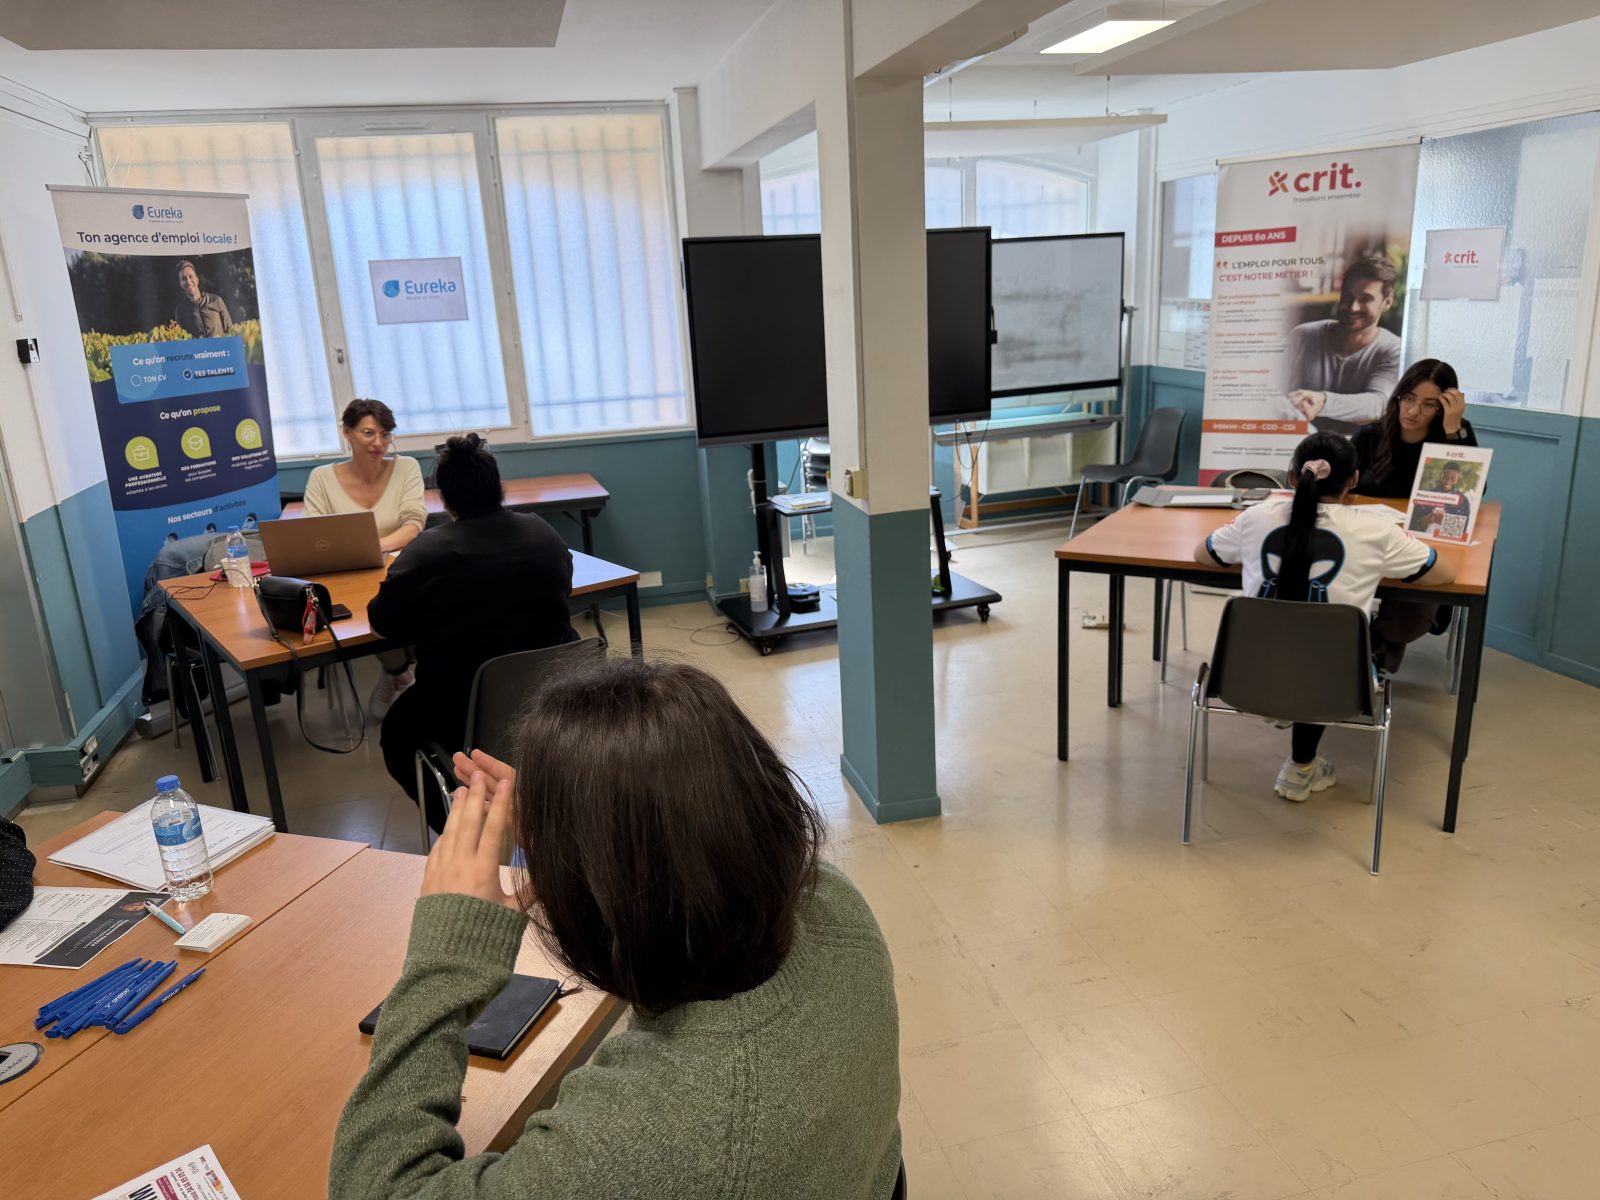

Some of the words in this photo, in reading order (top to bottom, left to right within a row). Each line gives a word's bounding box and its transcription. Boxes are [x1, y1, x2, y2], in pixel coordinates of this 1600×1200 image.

[1294, 162, 1362, 192] crit.
[147, 206, 183, 219] Eureka
[77, 232, 100, 243] Ton
[104, 234, 148, 245] agence
[152, 232, 200, 245] d'emploi
[203, 234, 232, 244] locale
[1222, 233, 1253, 244] DEPUIS
[1255, 233, 1266, 242] 60
[1267, 231, 1286, 240] ANS
[1454, 250, 1479, 264] crit.
[1232, 260, 1270, 269] L'EMPLOI
[1219, 272, 1242, 282] C'EST
[1244, 272, 1273, 281] NOTRE
[405, 278, 456, 294] Eureka
[133, 357, 144, 366] Ce
[146, 356, 165, 365] qu'on
[167, 354, 193, 362] recrute
[194, 350, 227, 359] vraiment
[160, 411, 170, 420] Ce
[171, 410, 192, 419] qu'on
[193, 405, 221, 416] propose
[191, 460, 216, 470] FORMATIONS
[125, 476, 166, 487] PROFESSIONNELLE
[139, 471, 162, 480] AVENTURE
[168, 515, 181, 524] Nos
[182, 508, 212, 519] secteurs
[214, 500, 246, 512] d'activités
